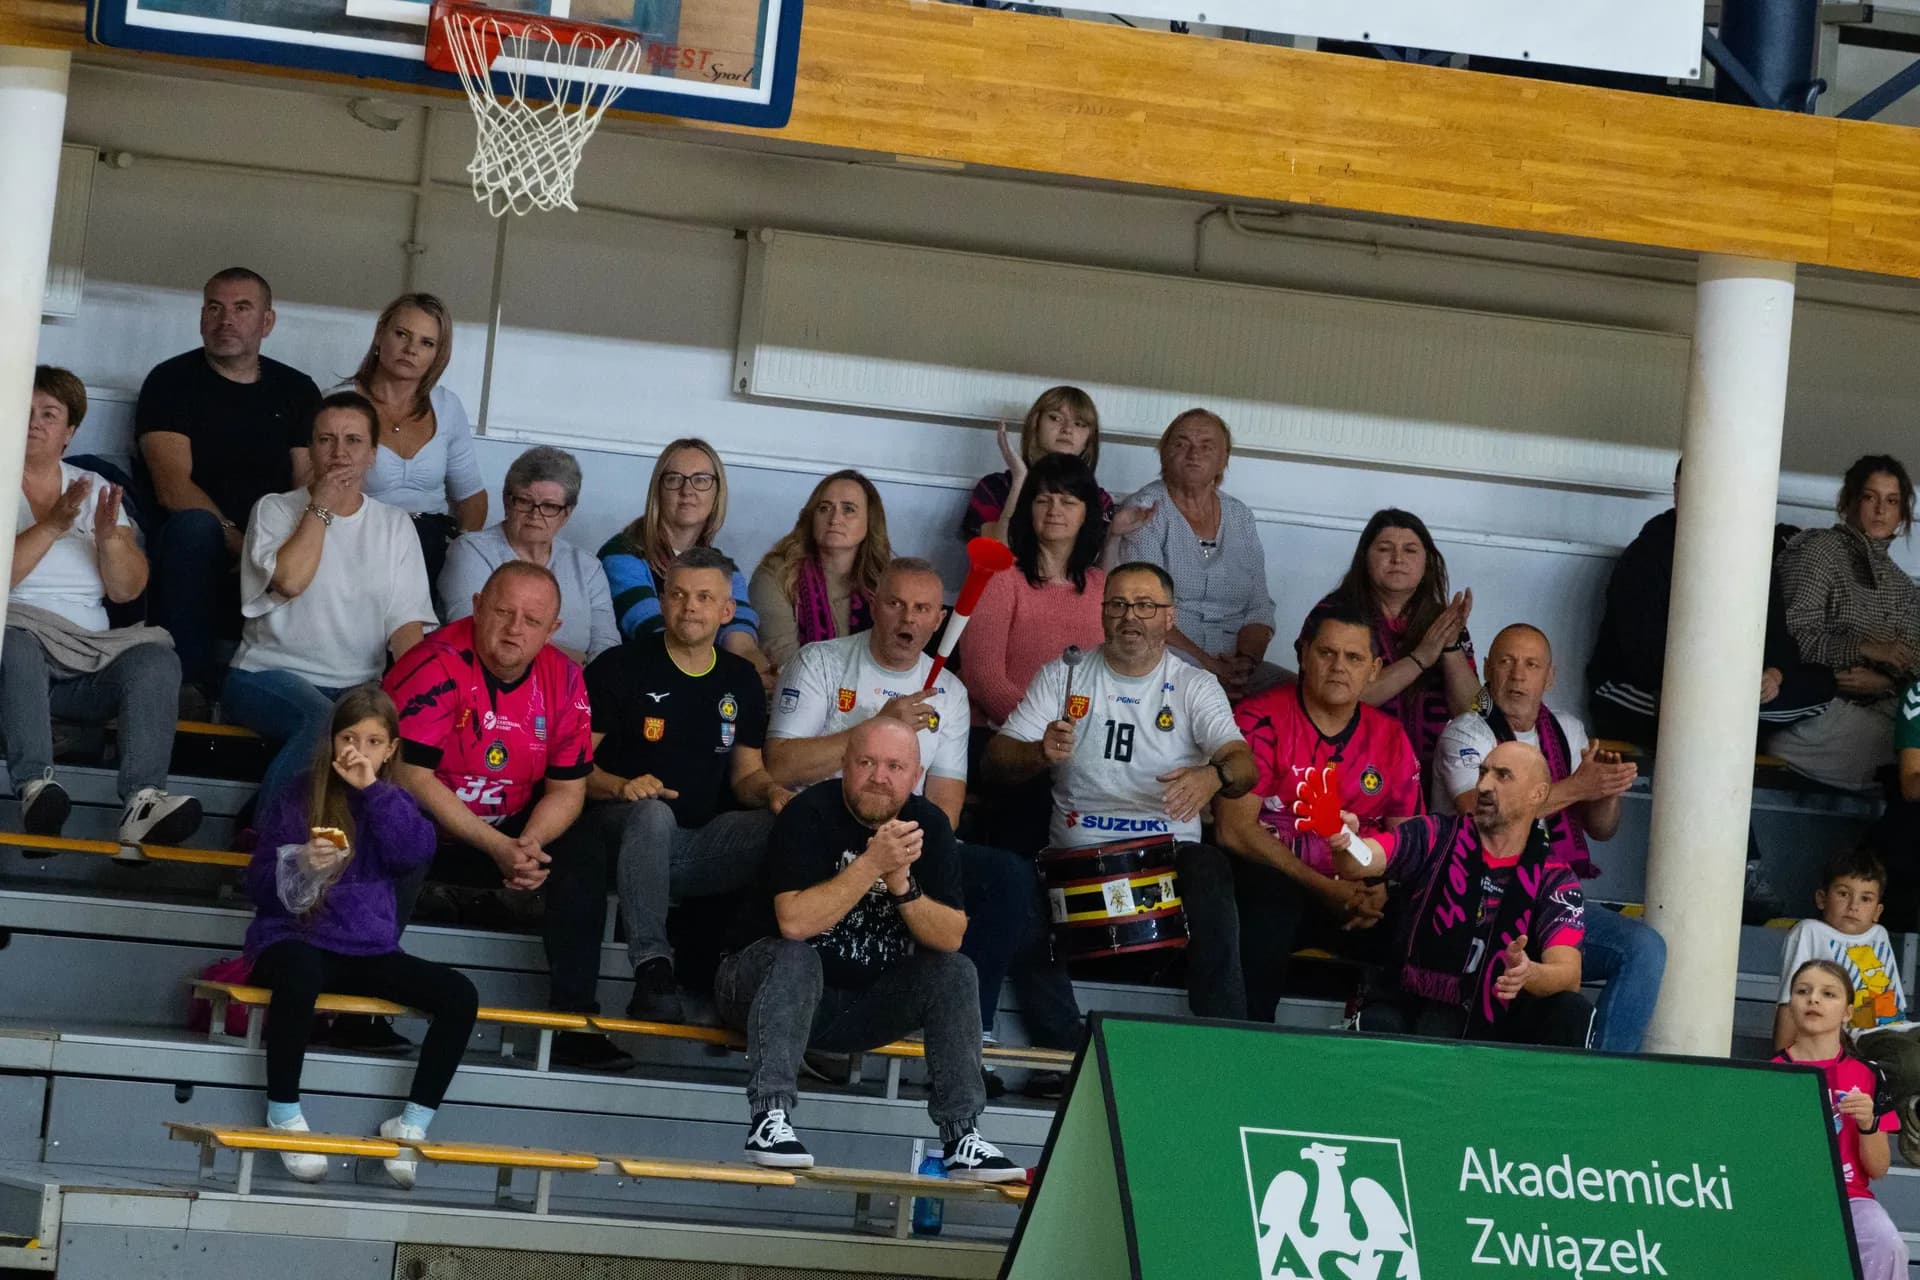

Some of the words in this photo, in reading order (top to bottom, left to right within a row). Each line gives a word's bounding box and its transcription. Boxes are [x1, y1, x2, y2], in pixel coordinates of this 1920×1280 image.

[646, 42, 713, 70] BEST
[703, 63, 754, 82] Sport
[1104, 719, 1135, 763] 18
[456, 775, 513, 804] 32
[1081, 815, 1169, 832] SUZUKI
[1459, 1146, 1733, 1210] Akademicki
[1465, 1217, 1668, 1280] Związek
